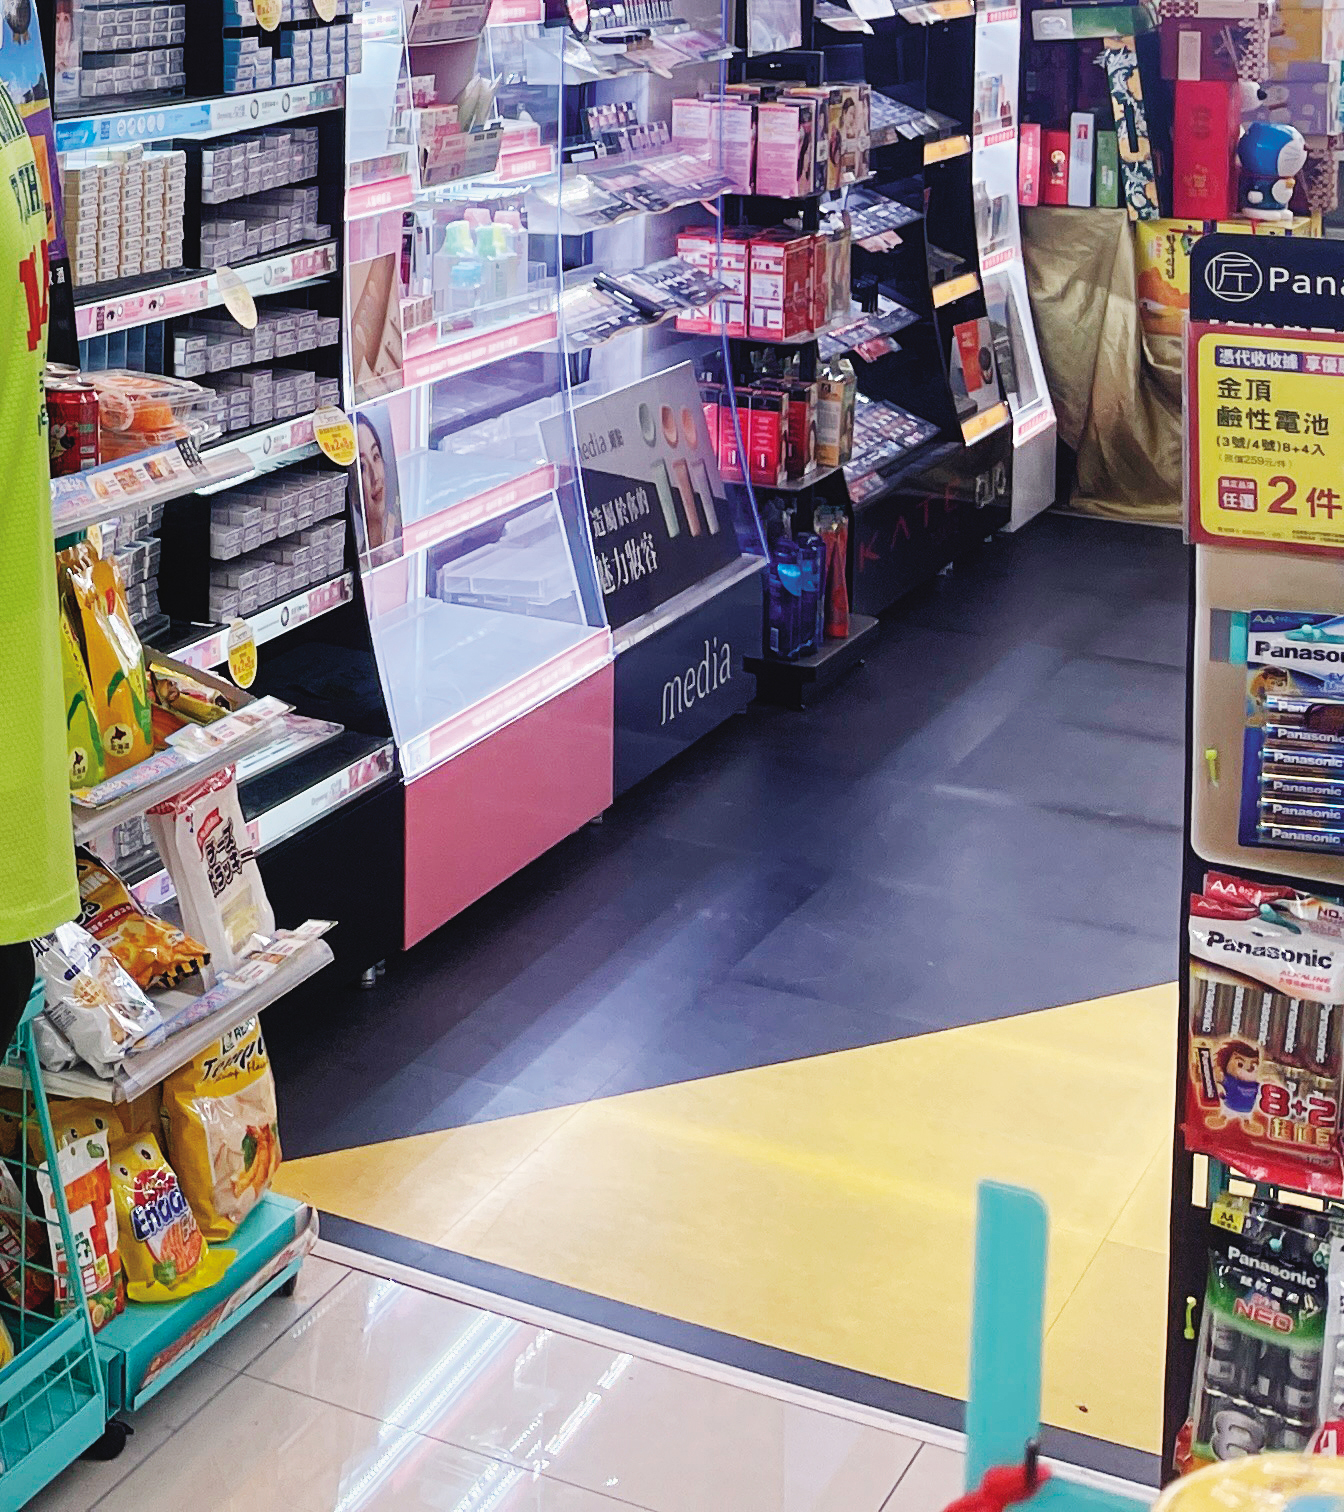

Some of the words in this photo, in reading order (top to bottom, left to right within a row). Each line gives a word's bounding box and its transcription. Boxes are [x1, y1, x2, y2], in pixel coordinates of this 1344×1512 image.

[1217, 377, 1272, 402] 金頂
[1217, 405, 1330, 436] 鹼性電池
[661, 639, 731, 725] media
[1277, 727, 1344, 744] Panasonic
[1274, 752, 1343, 769] Panasonic
[1273, 780, 1342, 797] Panasonic
[1272, 803, 1341, 821] Panasonic
[1272, 828, 1340, 845] Panasonic
[1211, 879, 1238, 896] AA
[1207, 930, 1332, 970] Panasonic
[1227, 1245, 1318, 1290] Panasonic
